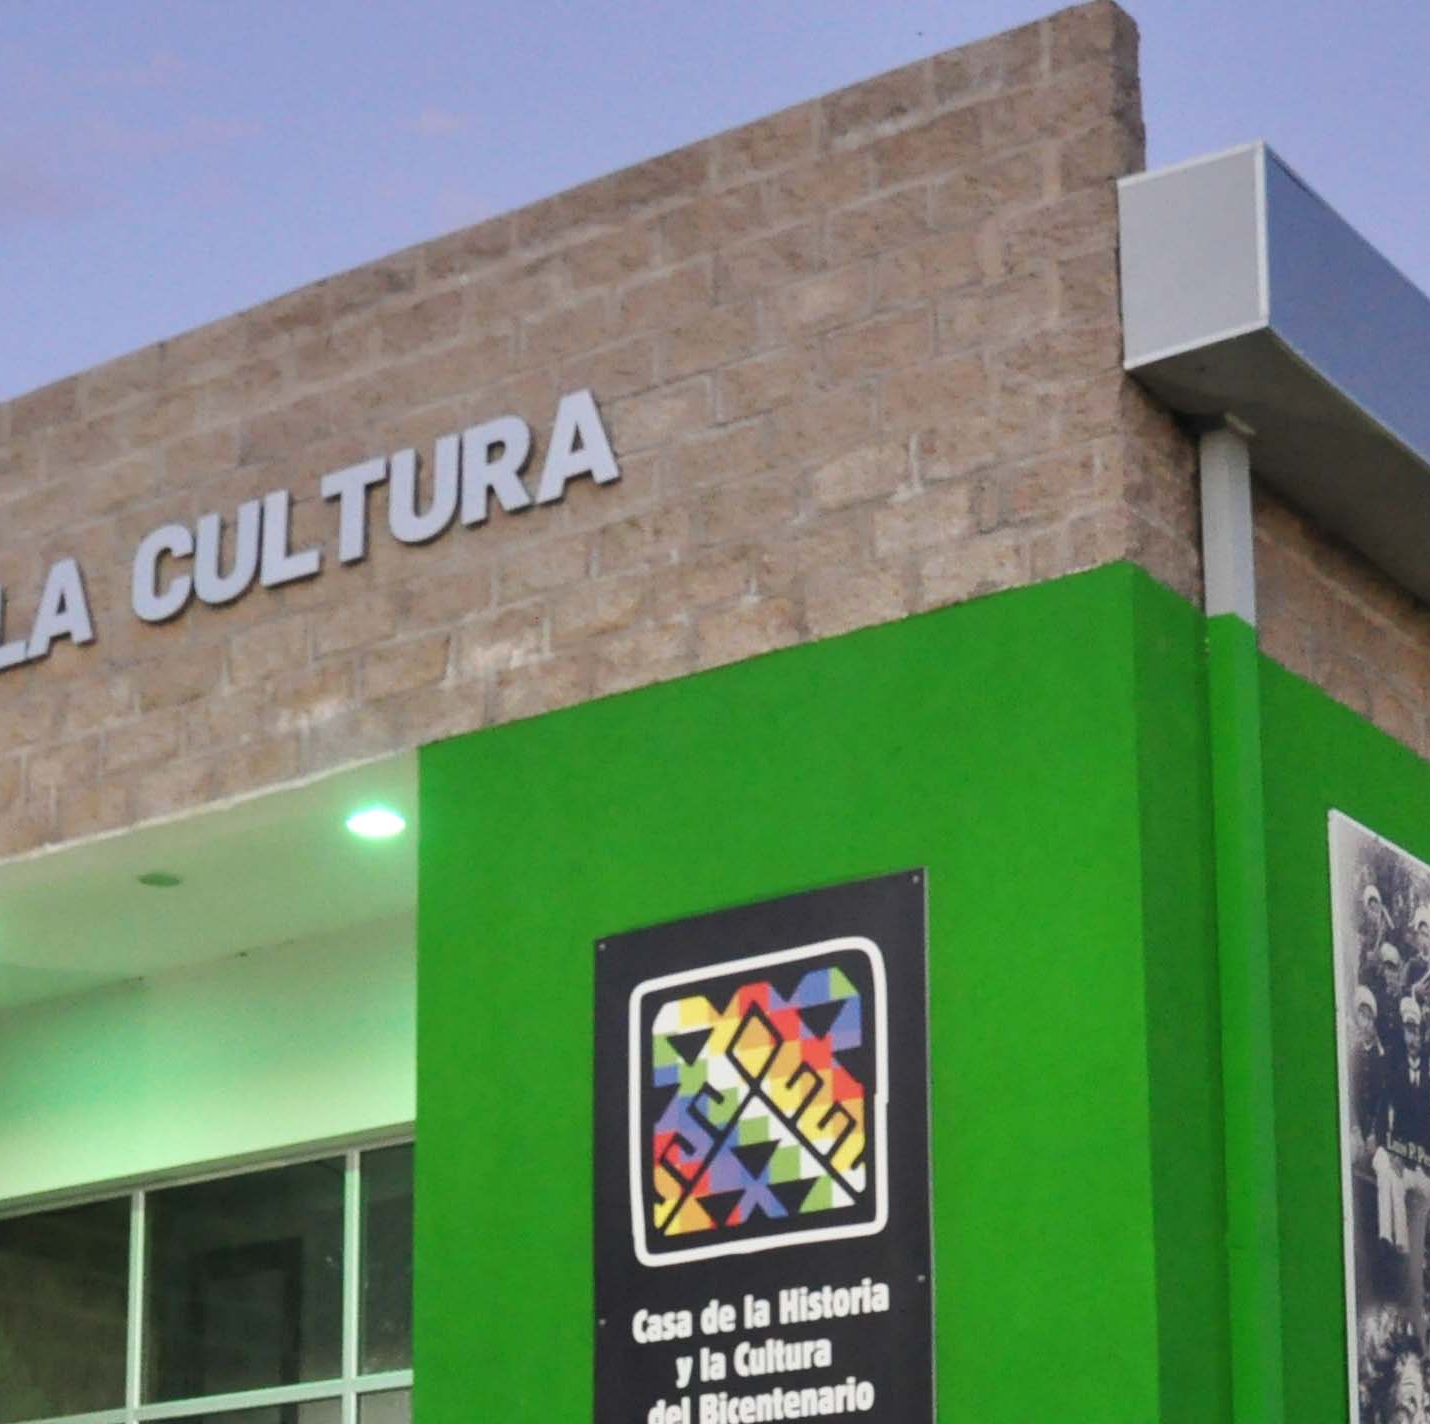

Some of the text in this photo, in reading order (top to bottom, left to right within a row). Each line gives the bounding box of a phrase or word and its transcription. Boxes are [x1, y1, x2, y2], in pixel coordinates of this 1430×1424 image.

[132, 390, 619, 622] CULTURA
[632, 1277, 890, 1344] Casa de la Historia
[676, 1338, 832, 1388] y la Cultura
